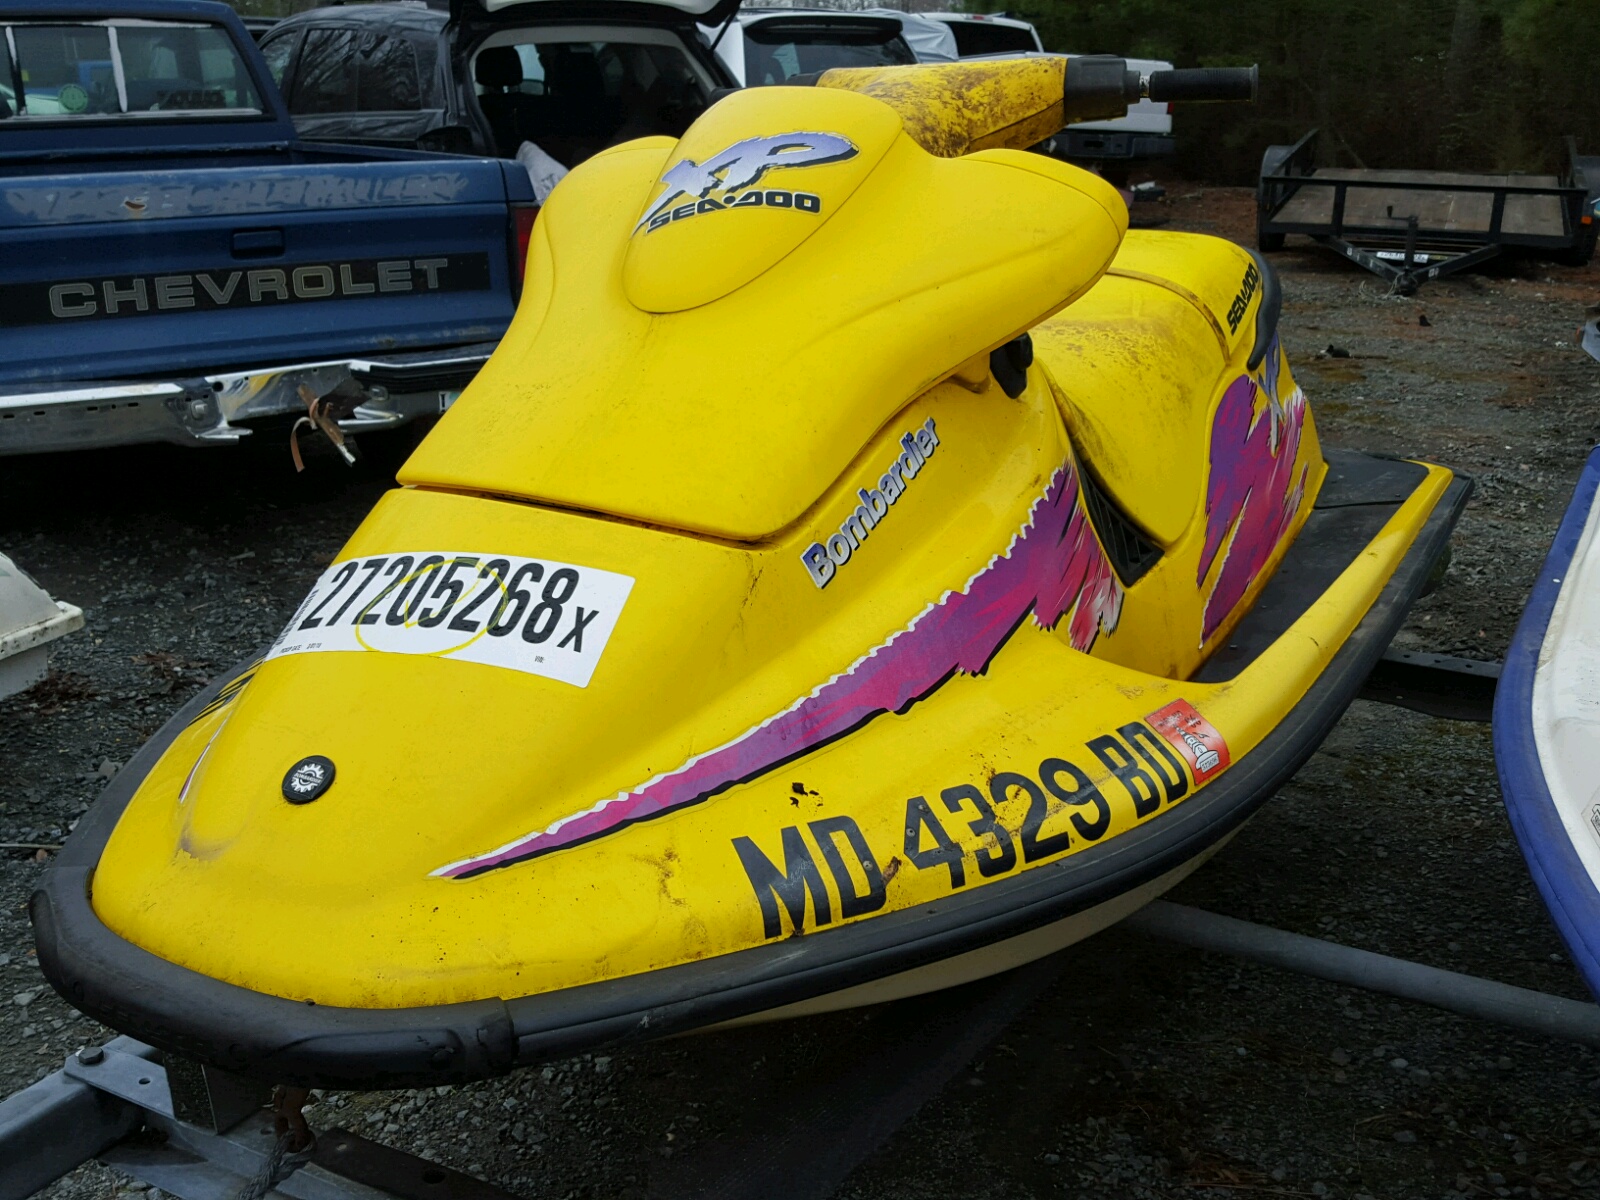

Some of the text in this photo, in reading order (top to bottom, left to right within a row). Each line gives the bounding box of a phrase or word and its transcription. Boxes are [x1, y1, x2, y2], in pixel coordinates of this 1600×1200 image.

[633, 131, 860, 238] XP
[49, 258, 448, 318] CHEVROLET
[800, 416, 940, 589] Bombardier
[731, 721, 1189, 940] MD 4329 BD
